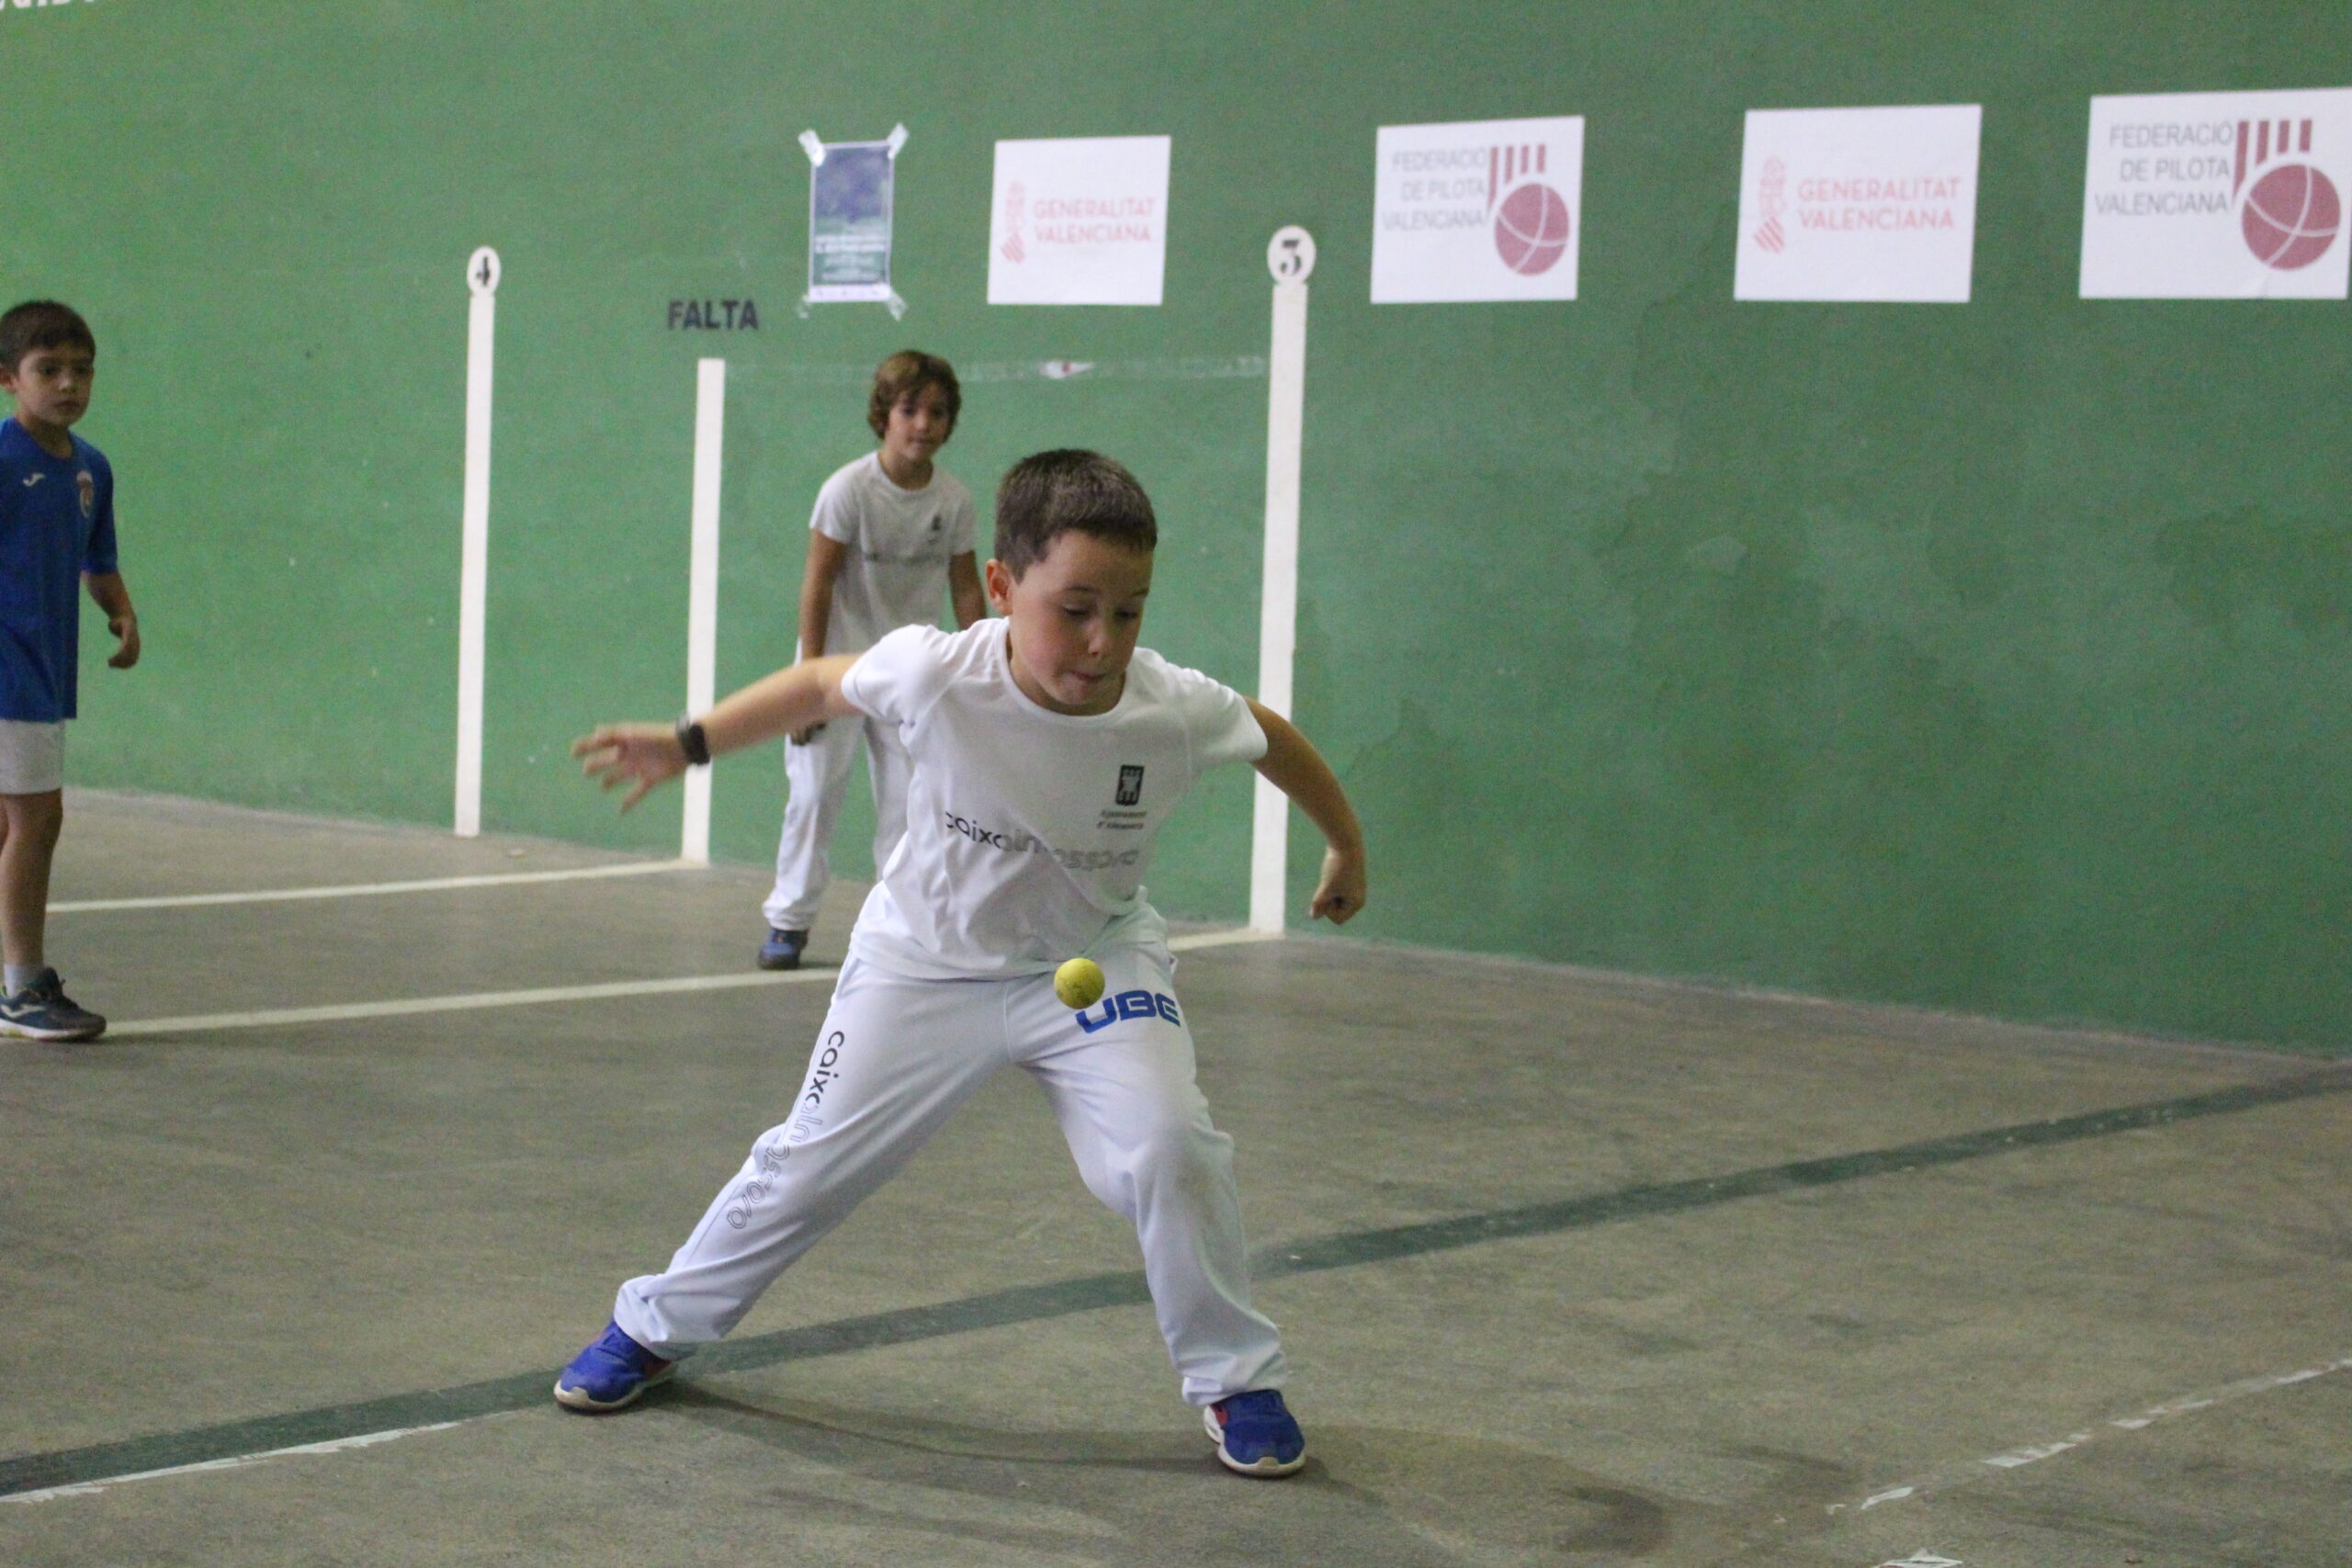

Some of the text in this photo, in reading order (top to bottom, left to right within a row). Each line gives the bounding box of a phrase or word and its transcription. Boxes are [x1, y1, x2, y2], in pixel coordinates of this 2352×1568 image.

[2120, 156, 2230, 182] DE PILOTA
[1401, 177, 1485, 201] DE PILOTA
[1797, 176, 1961, 202] GENERALITAT
[1034, 197, 1155, 219] GENERALITAT
[2095, 192, 2228, 216] VALENCIANA
[1382, 209, 1485, 231] VALENCIANA
[1799, 208, 1955, 231] VALENCIANA
[1035, 224, 1151, 243] VALENCIANA
[476, 256, 491, 287] 4
[668, 299, 759, 330] FALTA
[1076, 990, 1181, 1033] UBE
